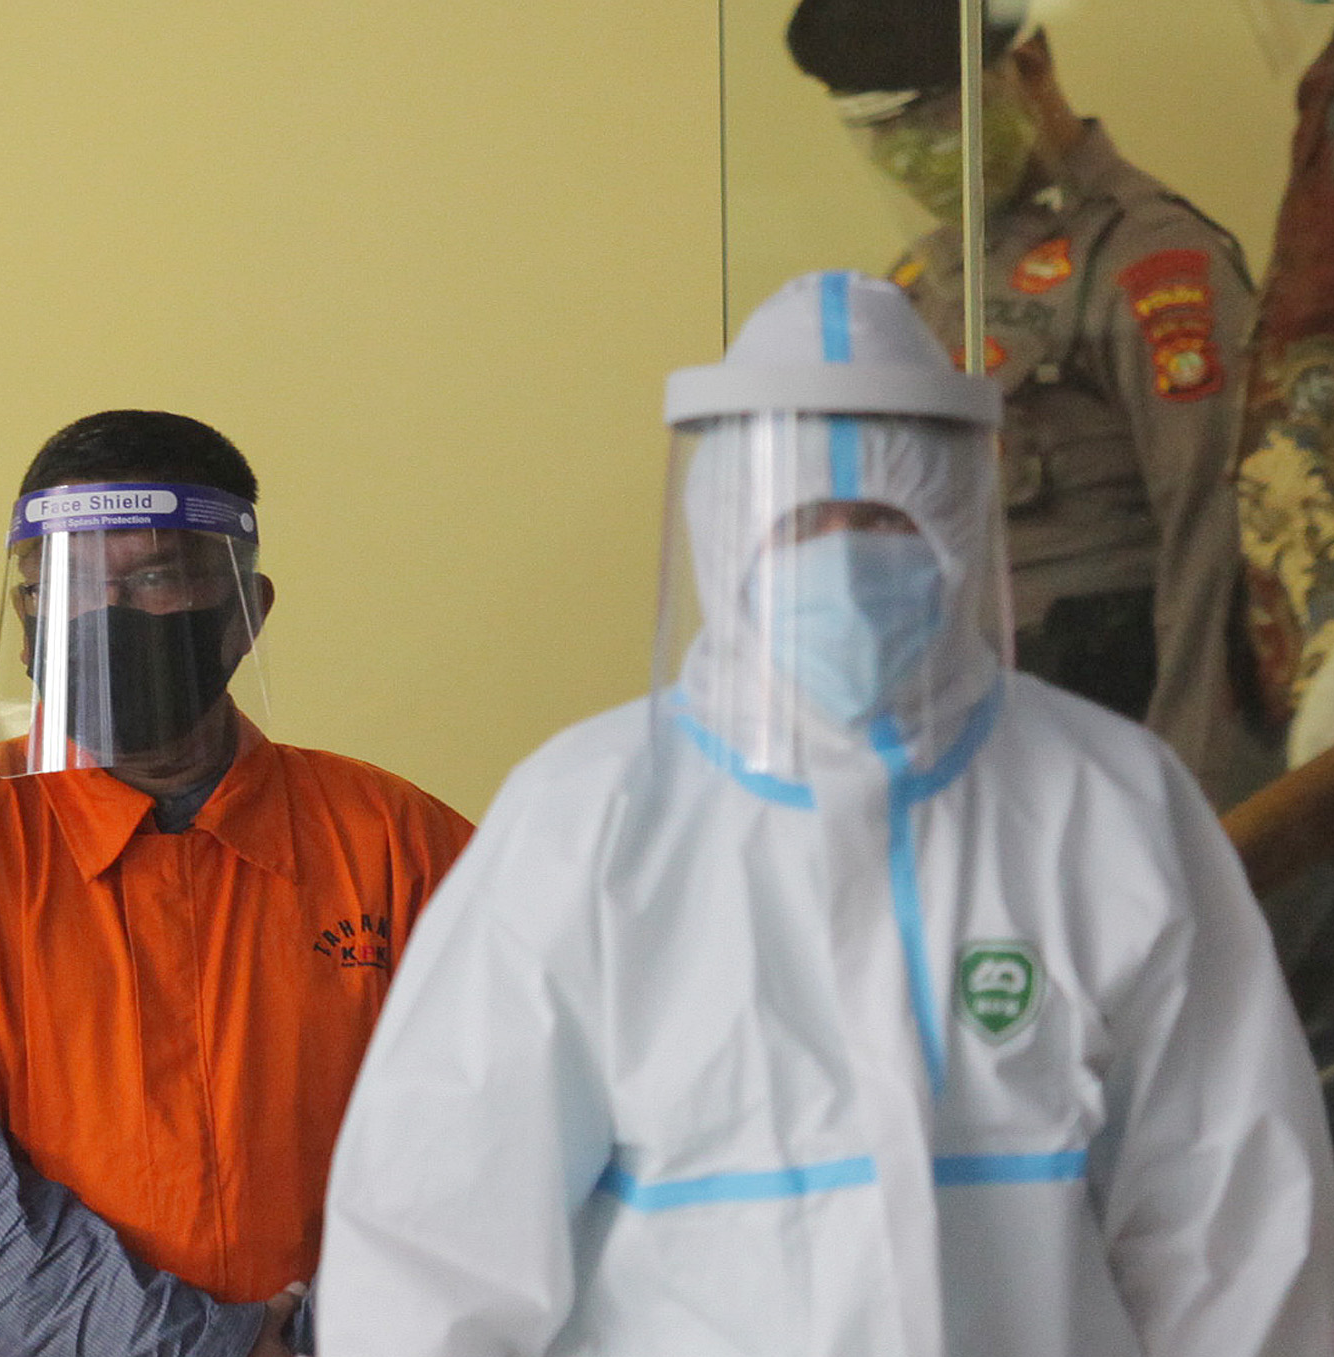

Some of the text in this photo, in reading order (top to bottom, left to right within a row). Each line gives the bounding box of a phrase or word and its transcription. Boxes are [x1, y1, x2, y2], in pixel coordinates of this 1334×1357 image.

[40, 494, 152, 515] Face Shield
[102, 516, 151, 525] Protection
[341, 945, 390, 963] KPK
